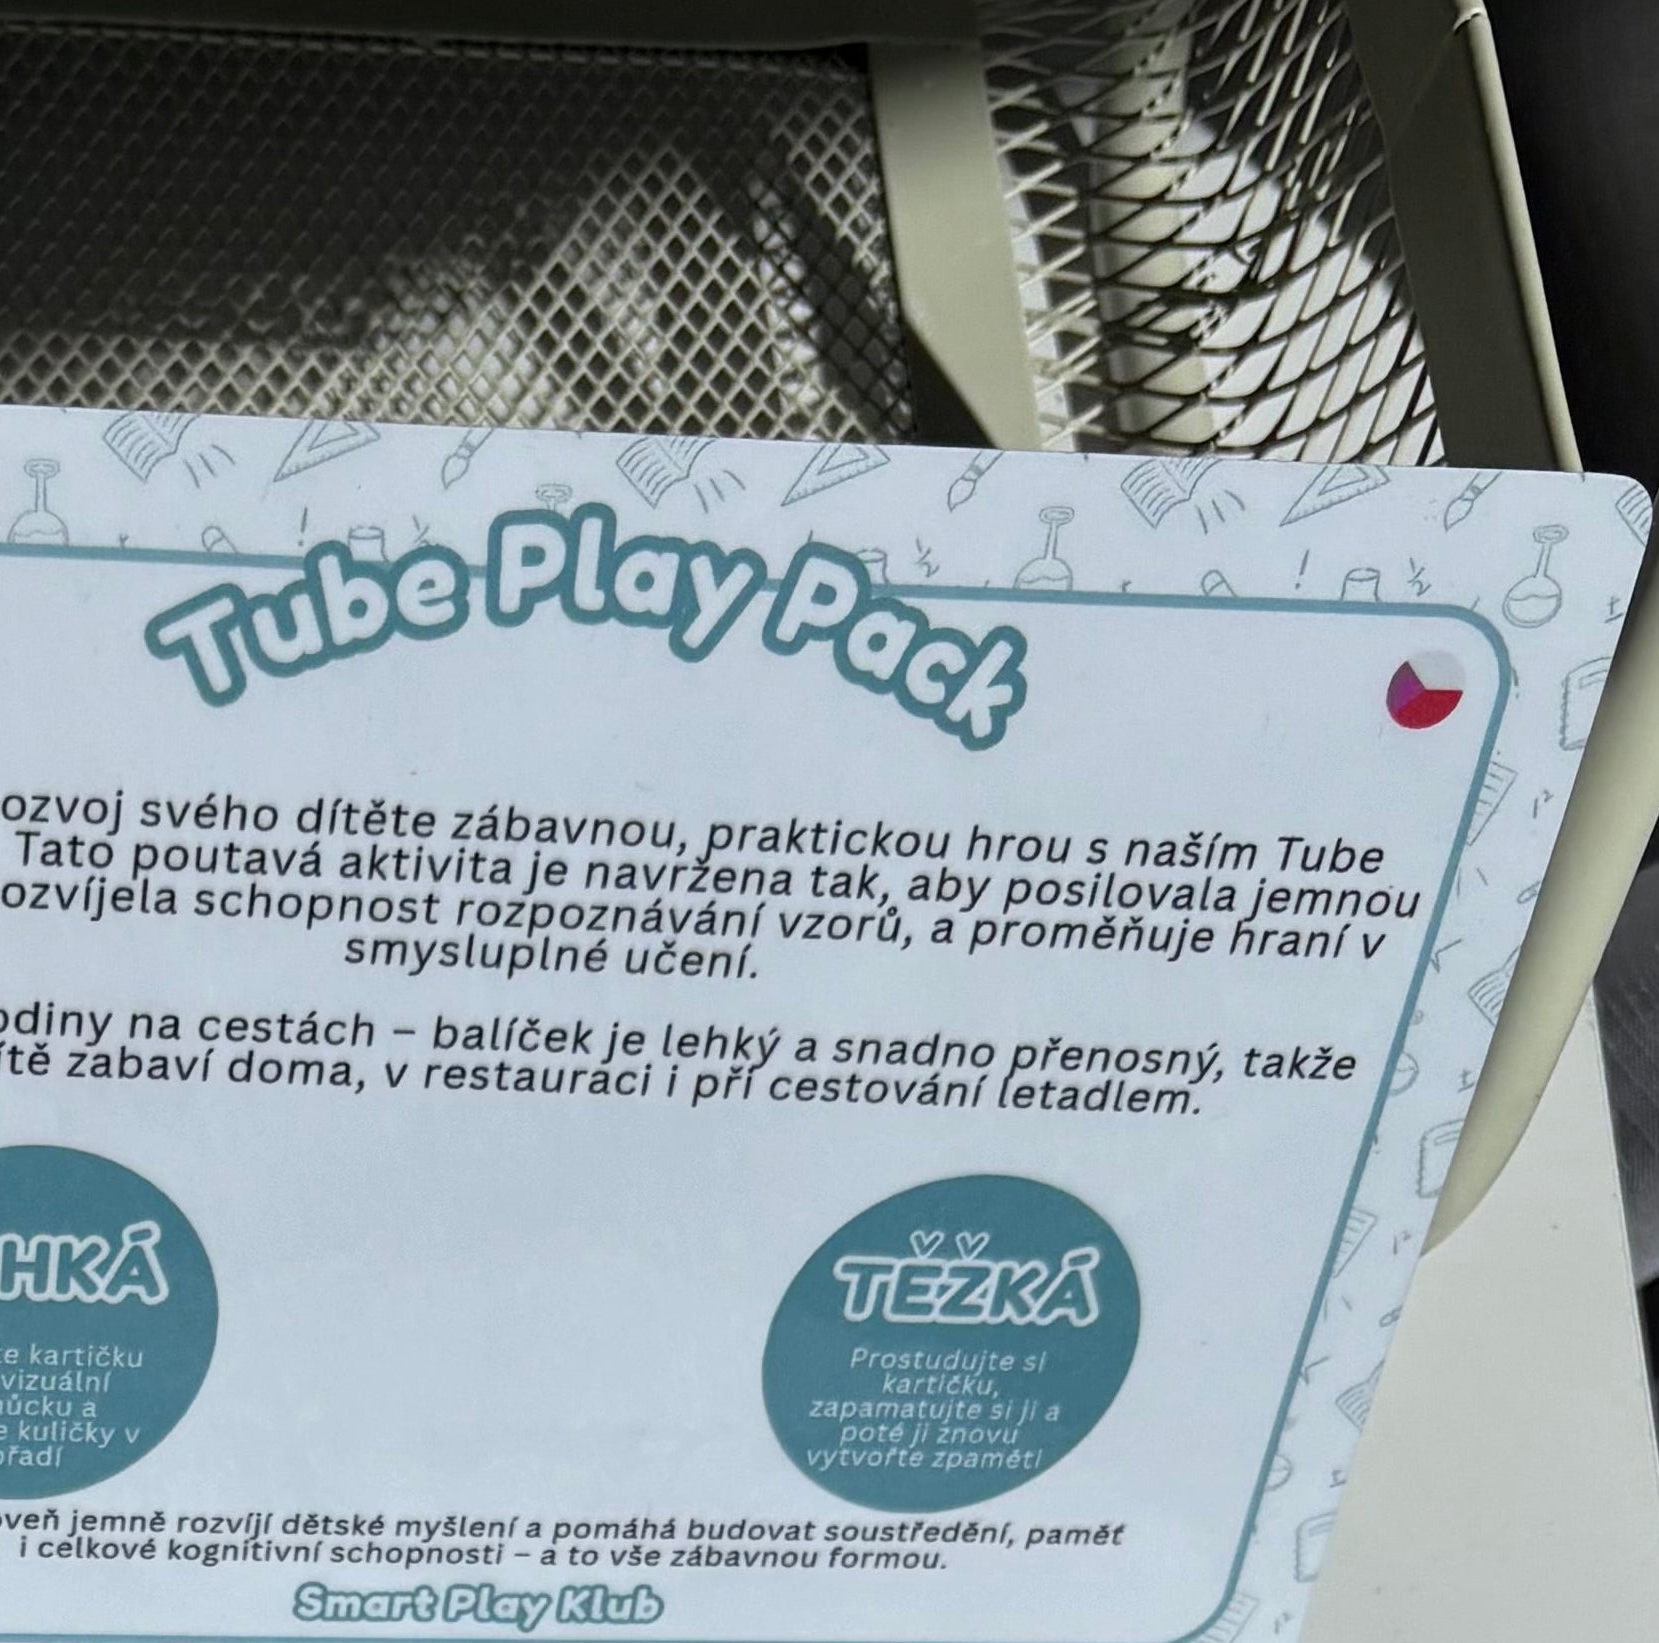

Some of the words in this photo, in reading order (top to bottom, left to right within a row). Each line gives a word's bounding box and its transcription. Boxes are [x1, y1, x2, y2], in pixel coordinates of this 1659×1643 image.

[145, 542, 468, 706] Tube
[488, 503, 765, 661] Play
[764, 541, 1028, 751] Pack
[140, 793, 278, 833] svého
[298, 797, 435, 839] dítěte
[451, 805, 687, 855] zábavnou,
[705, 818, 949, 862] praktickou
[967, 825, 1069, 863] hrou
[1086, 837, 1107, 863] s
[1125, 831, 1257, 871] naším
[1279, 837, 1384, 874] Tube
[15, 831, 114, 869] Tato
[133, 840, 321, 880] poutavá
[341, 846, 512, 885] aktivita
[524, 851, 568, 896] je
[585, 857, 791, 898] navržena
[811, 864, 890, 904] tak,
[908, 869, 990, 913] aby
[1004, 873, 1236, 911] posilovala
[1246, 879, 1420, 921] jemnou
[194, 881, 438, 931] schopnost
[456, 896, 765, 937] rozpoznávání
[779, 905, 913, 949] vzorů,
[931, 918, 952, 944] a
[969, 915, 1213, 962] proměňuje
[1230, 920, 1347, 959] hraní
[1364, 931, 1386, 959] v
[345, 933, 607, 978] smysluplné
[625, 942, 758, 979] učení.
[130, 1012, 180, 1041] na
[199, 1011, 374, 1047] cestách
[433, 1015, 592, 1055] balíček
[603, 1021, 645, 1063] je
[662, 1023, 780, 1070] lehký
[795, 1037, 817, 1062] a
[833, 1034, 994, 1069] snadno
[1008, 1036, 1224, 1084] přenosný,
[1243, 1047, 1356, 1081] takže
[67, 1046, 210, 1083] zabaví
[228, 1051, 366, 1094] doma,
[386, 1061, 407, 1088] v
[425, 1058, 652, 1097] restauraci
[667, 1064, 678, 1097] i
[769, 1071, 986, 1108] cestování
[997, 1075, 1200, 1116] letadlem.
[833, 1230, 1100, 1327] TĚŽKÁ
[30, 1344, 143, 1368] kartičku
[851, 1348, 1014, 1377] Prostudujte
[1023, 1351, 1047, 1373] si
[2, 1370, 110, 1393] vizuální
[882, 1374, 998, 1398] kartičku,
[83, 1402, 96, 1417] a
[809, 1399, 980, 1424] zapamatujte
[990, 1401, 1010, 1419] si
[1018, 1401, 1036, 1426] ji
[1045, 1405, 1059, 1421] a
[19, 1421, 114, 1448] kuličky
[126, 1430, 140, 1443] v
[840, 1423, 903, 1448] poté
[910, 1424, 928, 1448] ji
[937, 1427, 1018, 1444] znovu
[807, 1447, 924, 1471] vytvořte
[932, 1450, 1042, 1472] zpaměti
[67, 1510, 165, 1537] jemně
[177, 1513, 273, 1540] rozvíjí
[282, 1513, 383, 1537] dětské
[395, 1515, 517, 1541] myšlení
[526, 1524, 541, 1540] a
[552, 1517, 675, 1545] pomáhá
[688, 1518, 816, 1542] budovat
[825, 1522, 1015, 1548] soustředění,
[1025, 1524, 1125, 1549] paměť
[20, 1538, 27, 1558] i
[38, 1537, 156, 1561] celkové
[168, 1539, 322, 1567] kognitivní
[330, 1541, 506, 1567] schopnosti
[540, 1550, 557, 1565] a
[567, 1547, 598, 1566] to
[611, 1546, 660, 1568] vše
[670, 1545, 817, 1569] zábavnou
[828, 1546, 948, 1571] formou.
[293, 1581, 437, 1625] Smart
[442, 1583, 552, 1633] Play
[555, 1584, 664, 1626] Klub
